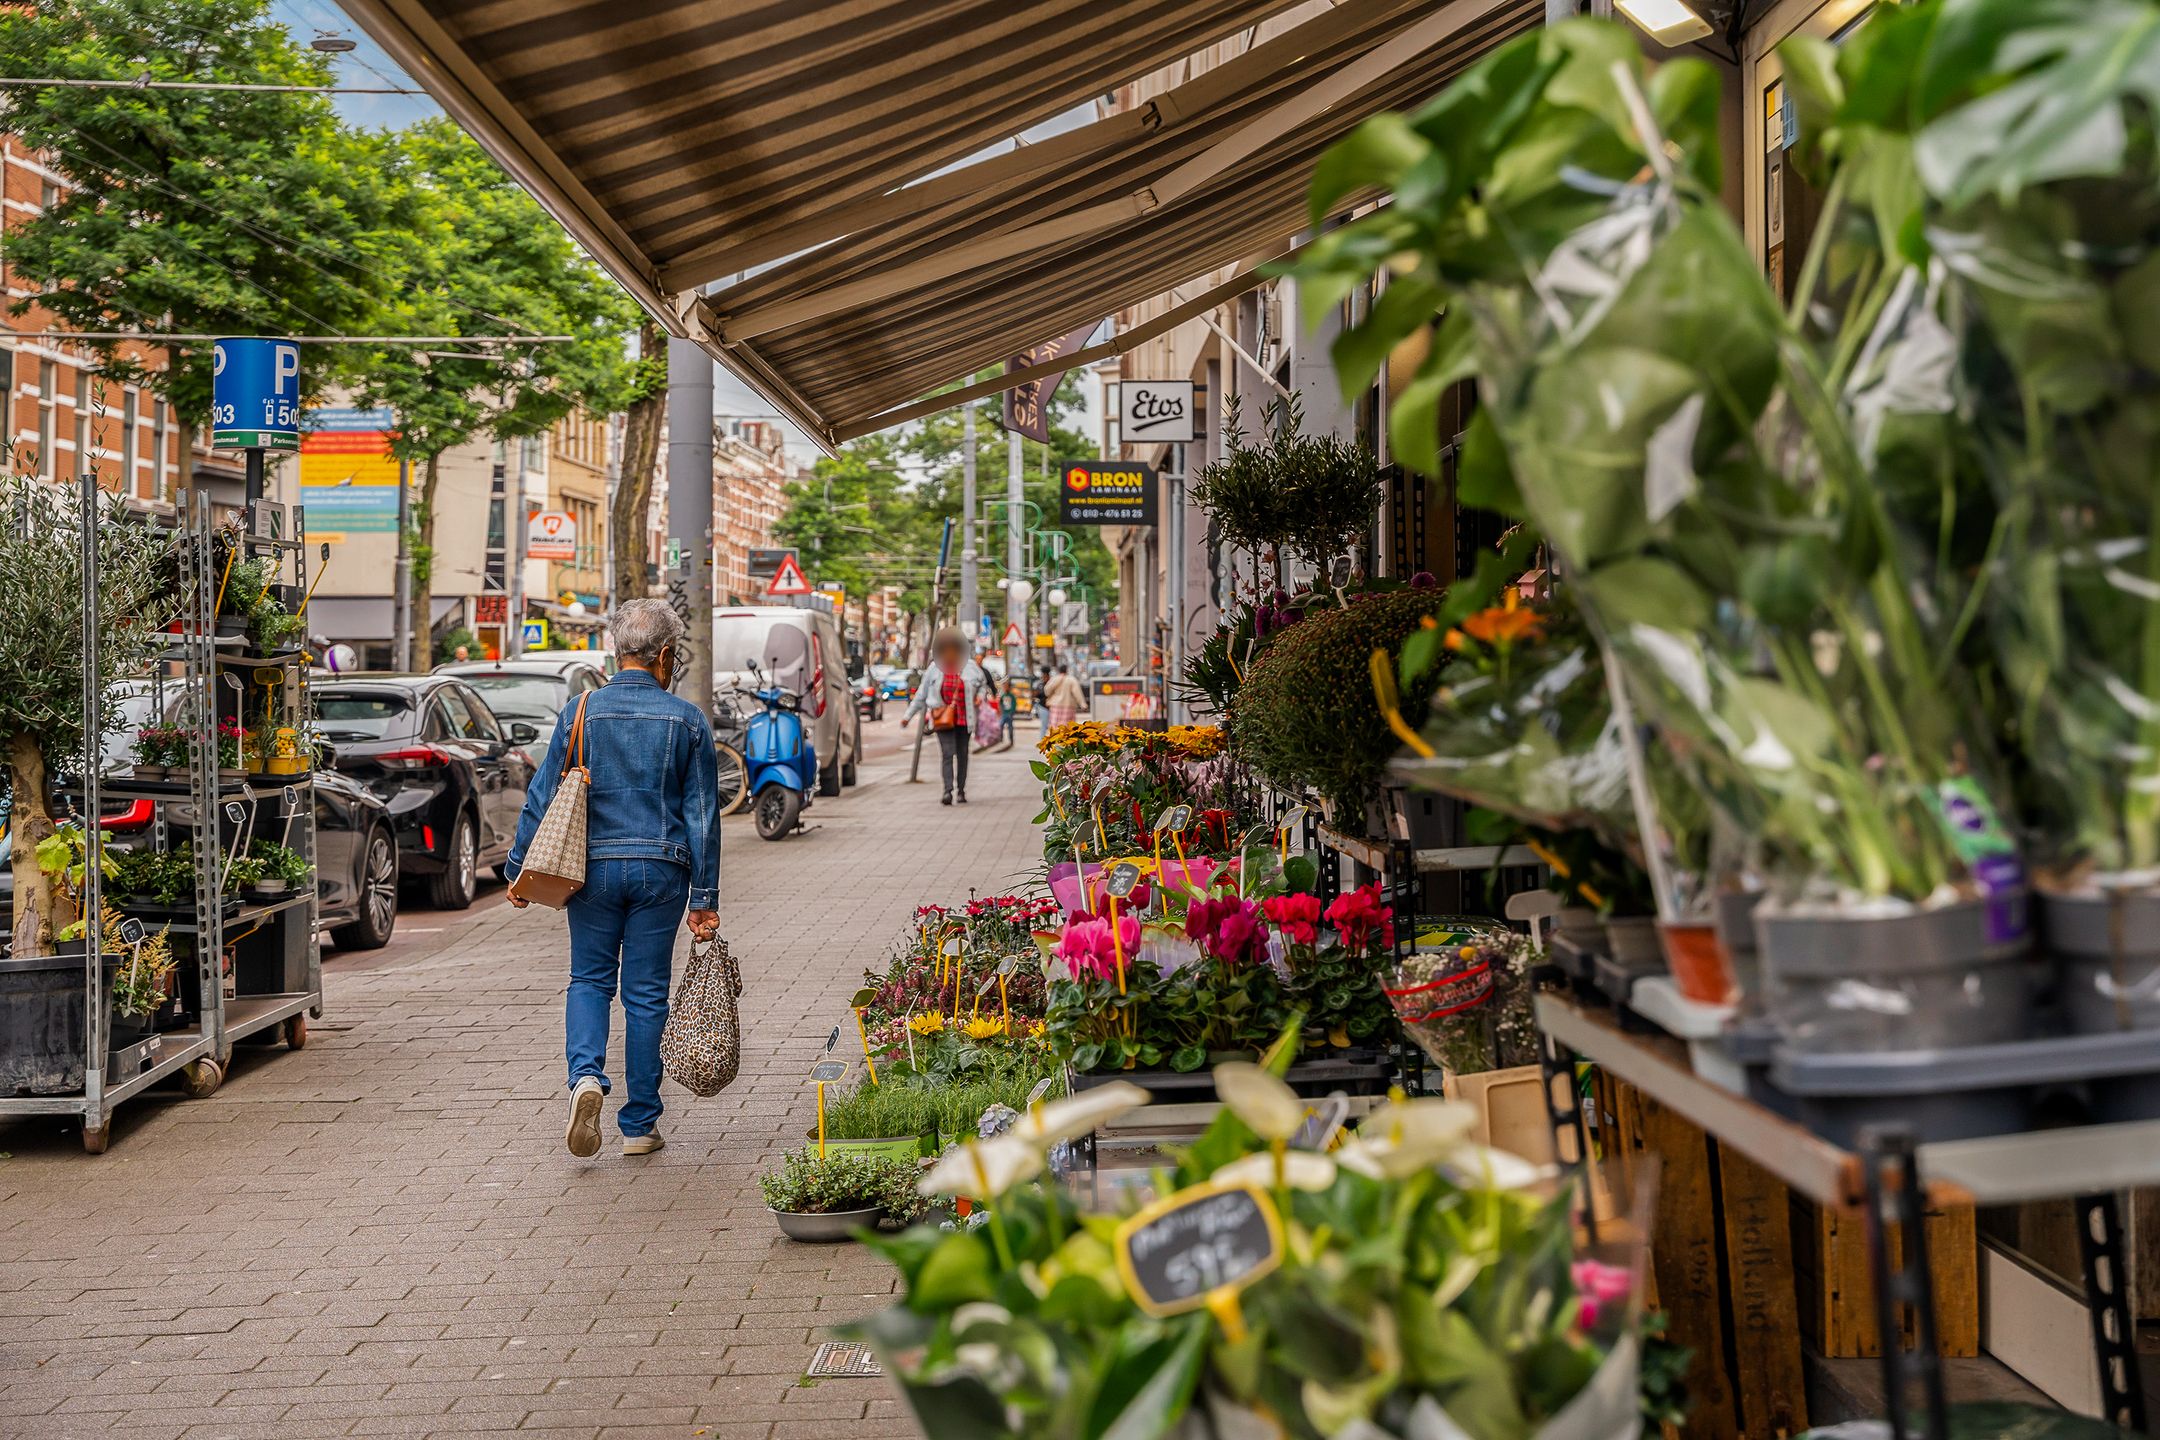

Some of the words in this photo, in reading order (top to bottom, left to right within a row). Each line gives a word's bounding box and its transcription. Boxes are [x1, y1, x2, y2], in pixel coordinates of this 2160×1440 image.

[275, 345, 299, 395] P
[1131, 390, 1184, 419] Etos
[1091, 472, 1143, 487] BRON
